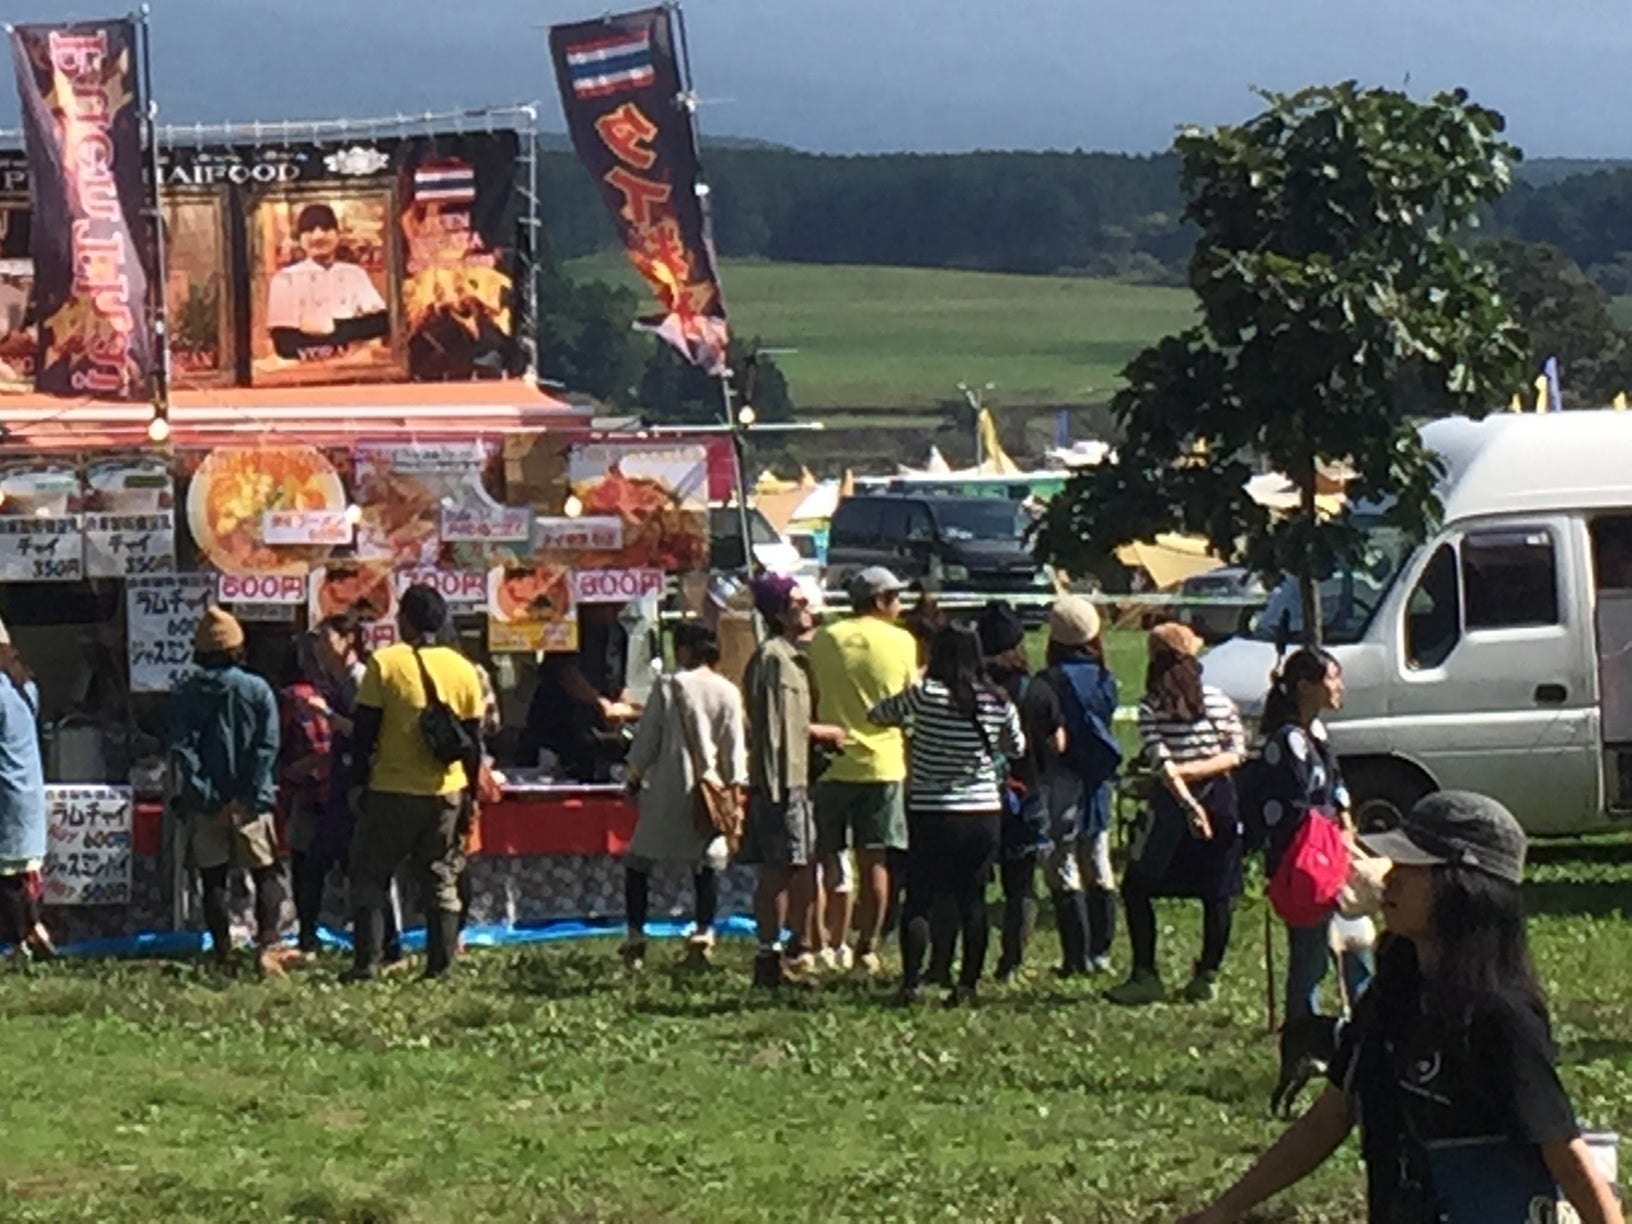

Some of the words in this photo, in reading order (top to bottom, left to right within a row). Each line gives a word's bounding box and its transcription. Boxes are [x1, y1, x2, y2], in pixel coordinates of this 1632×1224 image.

[16, 536, 60, 556] チャイ
[108, 533, 152, 554] チャイ
[222, 574, 304, 599] 600円
[135, 588, 213, 614] ラムチャイ
[52, 801, 129, 827] ラムチャイ
